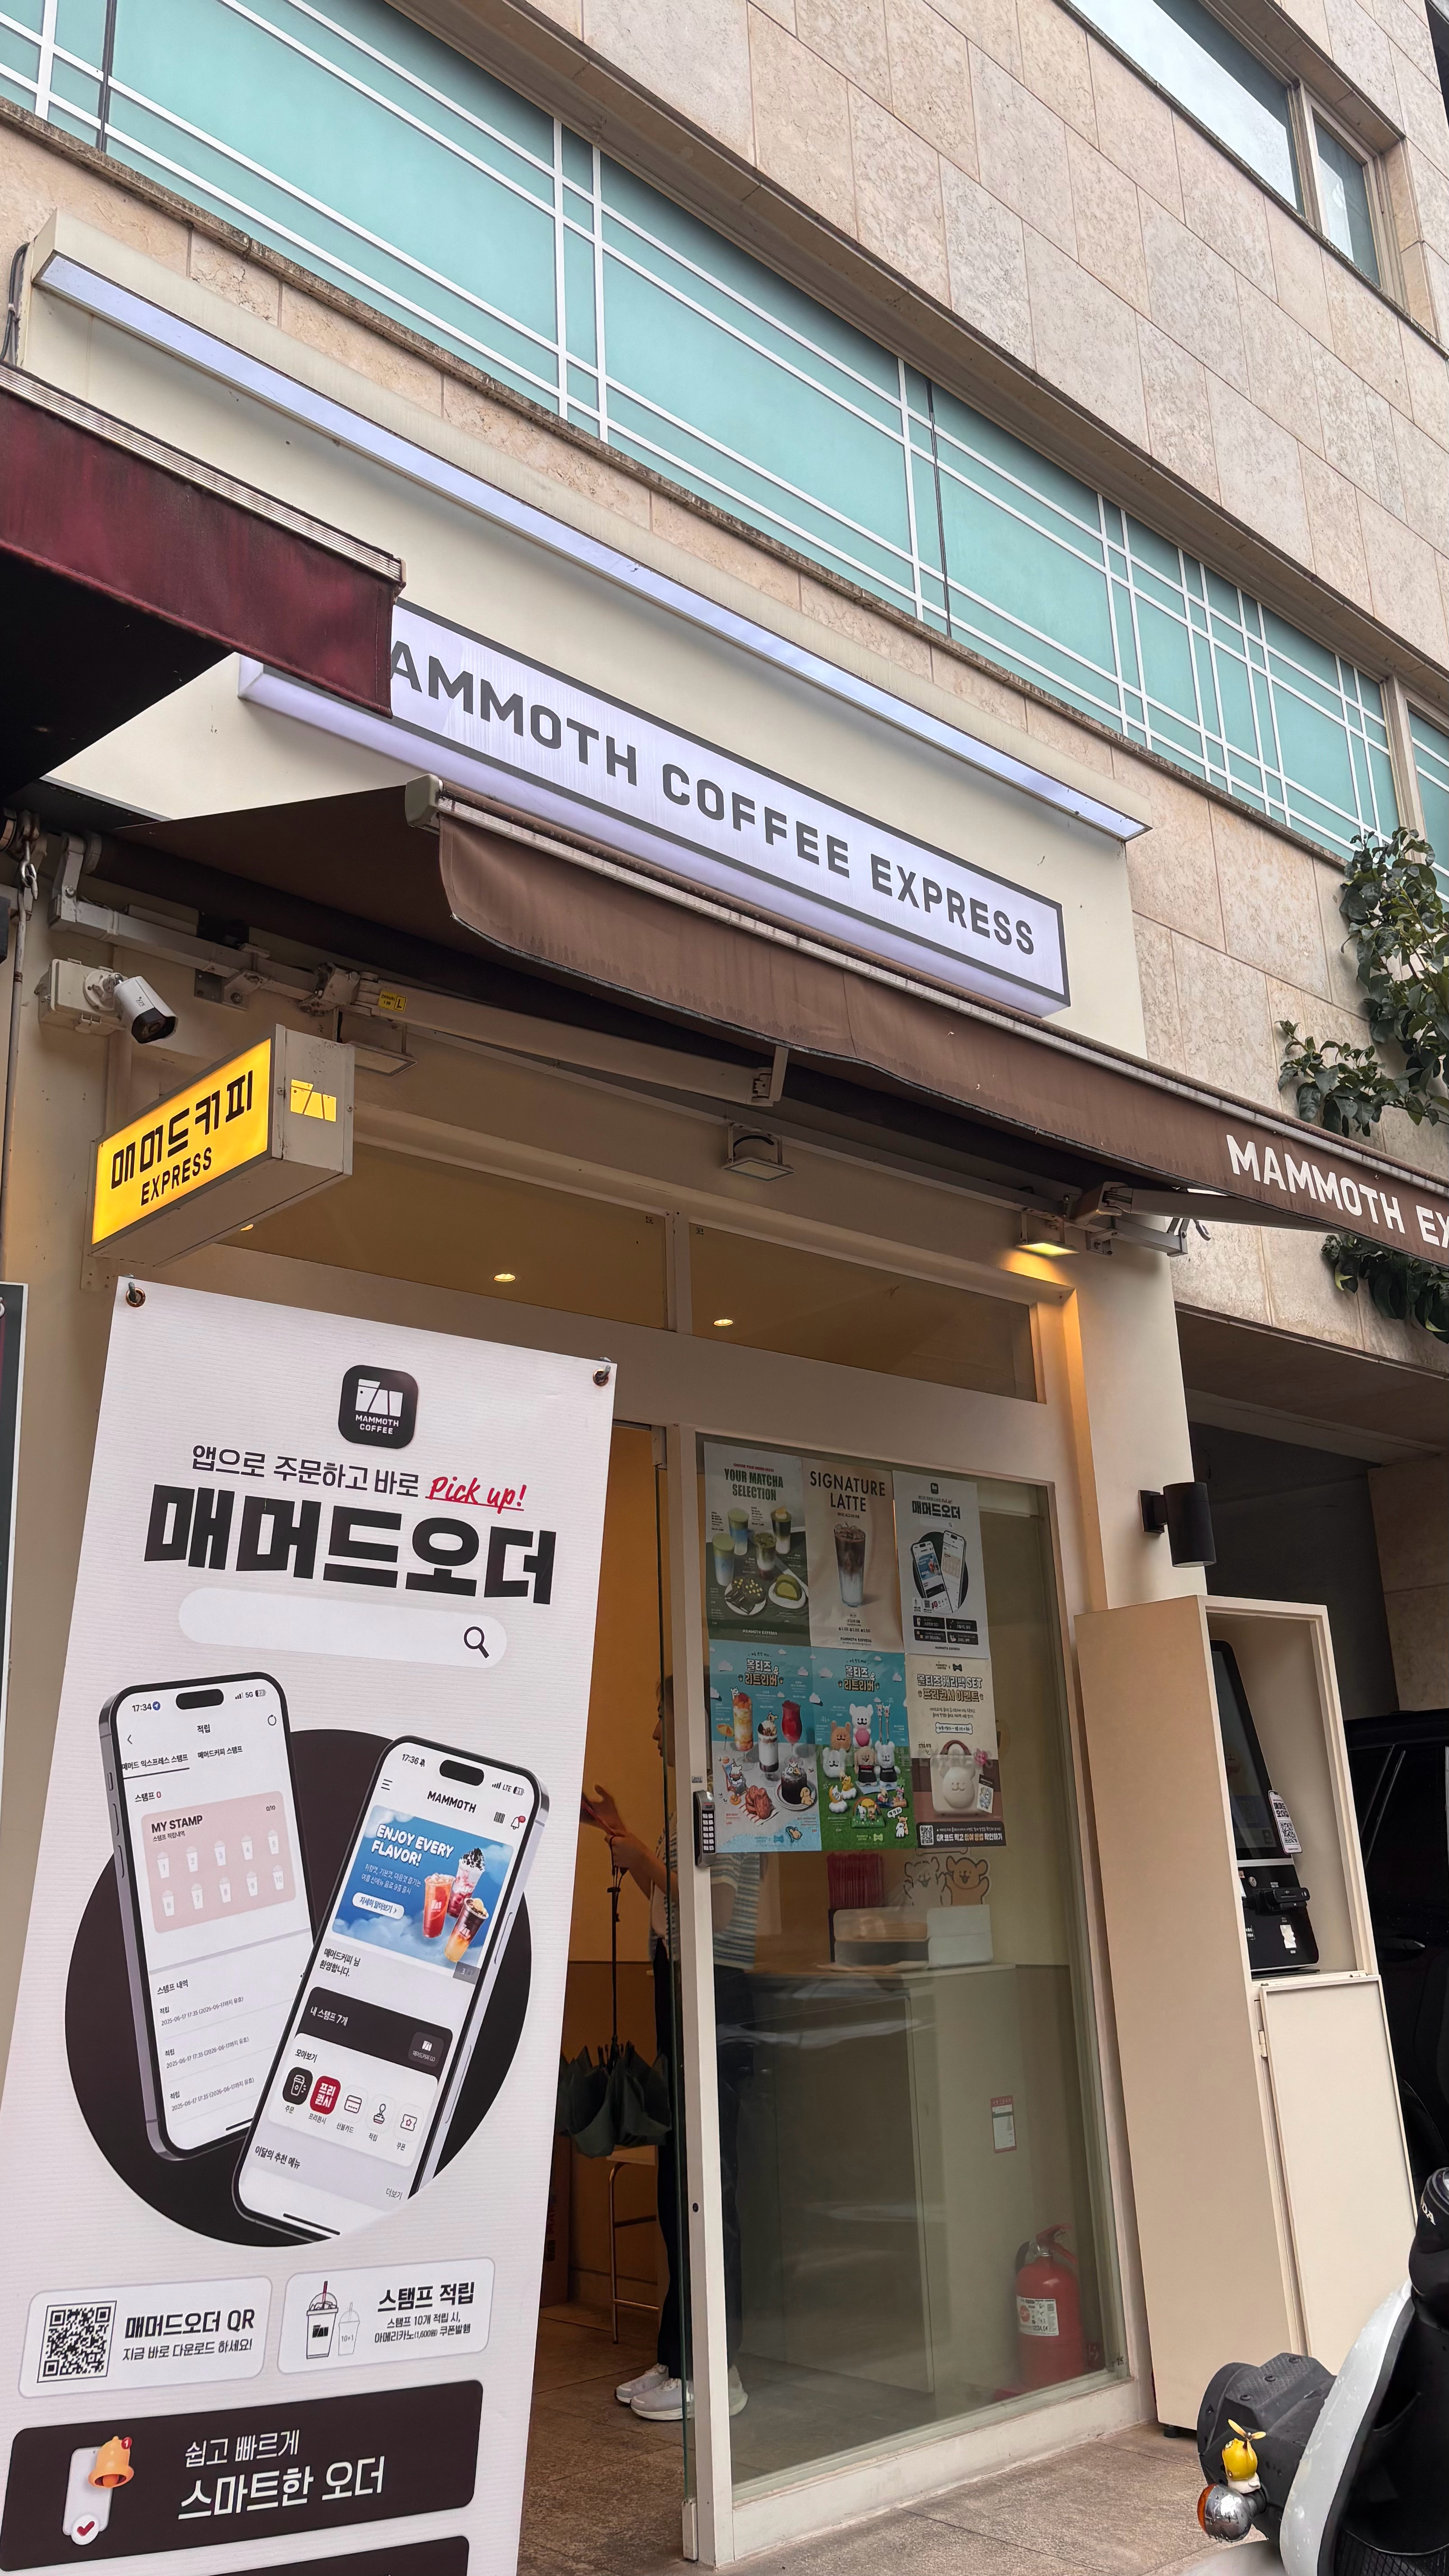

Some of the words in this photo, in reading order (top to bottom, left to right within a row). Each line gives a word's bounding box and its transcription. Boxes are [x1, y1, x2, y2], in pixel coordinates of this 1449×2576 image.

[391, 640, 637, 787] AMMOTH
[662, 763, 851, 879] COFFEE
[871, 853, 1034, 956] EXPRESS
[111, 1070, 253, 1189] 매머드커피
[141, 1147, 212, 1206] EXPRESS
[1226, 1134, 1405, 1234] MAMMOTH
[355, 1414, 399, 1427] MAMMOTH
[360, 1424, 393, 1434] COFFEE
[193, 1445, 265, 1477] 앱으로
[273, 1455, 368, 1491] 주문하고
[374, 1469, 419, 1497] 바로
[428, 1476, 481, 1504] Pick
[487, 1484, 527, 1514] up!
[724, 1468, 747, 1482] YOUR
[749, 1472, 783, 1488] MATCHA
[810, 1471, 885, 1496] SIGNATURE
[732, 1484, 776, 1501] SELECTION
[830, 1493, 866, 1512] LATTE
[912, 1500, 961, 1519] 매머드오더
[144, 1484, 557, 1605] 매머드오더
[747, 1658, 771, 1672] 몰티즈
[845, 1665, 868, 1678] 몰티즈
[745, 1673, 778, 1686] 리트리버
[844, 1679, 874, 1692] 리트리버
[917, 1674, 942, 1687] 몰티즈
[967, 1677, 982, 1688] SET
[923, 1688, 956, 1701] 프리퀀시
[956, 1690, 980, 1702] 이벤트
[132, 1703, 152, 1712] 17:34
[197, 1724, 211, 1734] 적립
[198, 1748, 225, 1759] 매머드커피
[226, 1745, 243, 1755] 스탬프
[141, 1757, 170, 1768] 익스프레스
[171, 1754, 188, 1763] 스탬프
[402, 1754, 419, 1765] 17:36
[502, 1783, 512, 1792] LTE
[135, 1792, 155, 1802] 스탬프
[427, 1790, 477, 1813] MAMMOTH
[151, 1821, 167, 1834] MY
[169, 1815, 203, 1830] STAMP
[376, 1823, 415, 1846] ENJOY
[415, 1836, 454, 1858] EVERY
[937, 1834, 943, 1842] QR
[371, 1840, 423, 1867] FLAVOR!
[359, 1896, 373, 1908] 자세히
[373, 1900, 393, 1913] 알아보기
[324, 1948, 354, 1964] 매머드커피
[354, 1956, 361, 1967] 님
[319, 1959, 350, 1977] 환영합니다.
[157, 1983, 175, 1995] 스탬프
[176, 1979, 189, 1989] 내역
[161, 2012, 186, 2026] 2025-06-17
[310, 2006, 317, 2016] 내
[317, 2009, 336, 2022] 스탬프
[337, 2014, 349, 2027] 7개
[166, 2055, 192, 2069] 2025-06-17
[295, 2049, 318, 2063] 모아보기
[319, 2083, 336, 2097] 프리
[171, 2097, 197, 2111] 2025-06-17
[285, 2105, 294, 2114] 주문
[315, 2094, 333, 2108] 퀀시
[254, 2145, 273, 2161] 이달의
[274, 2152, 287, 2165] 추천
[288, 2157, 301, 2170] 메뉴
[385, 2188, 403, 2201] 더보기
[377, 2286, 433, 2312] 스탬프
[440, 2282, 474, 2306] 적립
[124, 2310, 221, 2339] 매머드오더
[227, 2309, 255, 2332] QR
[386, 2316, 411, 2329] 스탬프
[414, 2314, 431, 2326] 10개
[433, 2313, 449, 2324] 적립
[451, 2312, 460, 2323] 시,
[341, 2334, 354, 2342] 10+1
[440, 2323, 471, 2337] 쿠폰발행
[122, 2346, 145, 2361] 지금
[148, 2345, 170, 2359] 바로
[172, 2341, 215, 2357] 다운로드
[218, 2338, 253, 2353] 하세요!
[123, 2438, 129, 2447] 1
[185, 2438, 229, 2468] 쉽고
[235, 2429, 299, 2462] 빠르게
[178, 2465, 314, 2520] 스마트한
[322, 2456, 385, 2501] 오더
